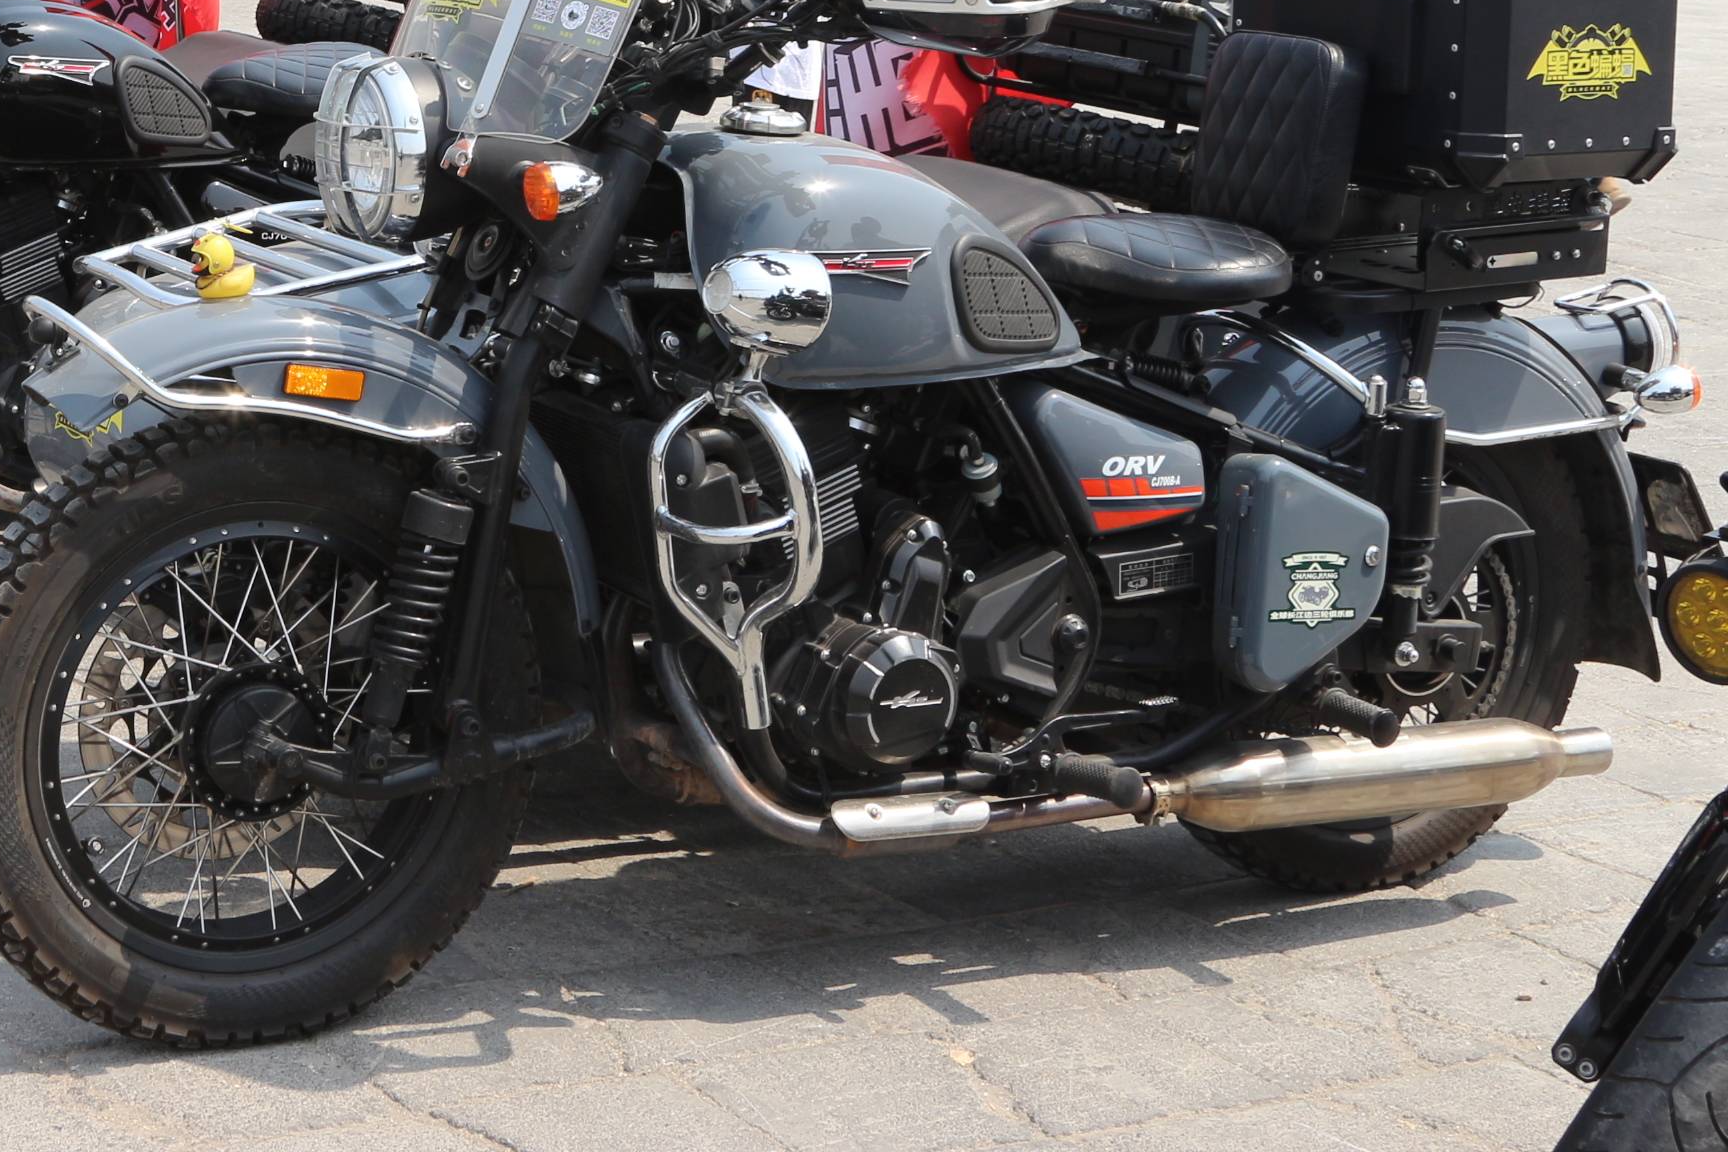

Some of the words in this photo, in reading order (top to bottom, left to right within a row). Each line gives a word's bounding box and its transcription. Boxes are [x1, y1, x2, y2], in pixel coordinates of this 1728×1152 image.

[1546, 49, 1635, 80] 黑色蝙蝠
[1102, 455, 1166, 476] ORV
[1291, 572, 1339, 581] CHANGJIANG
